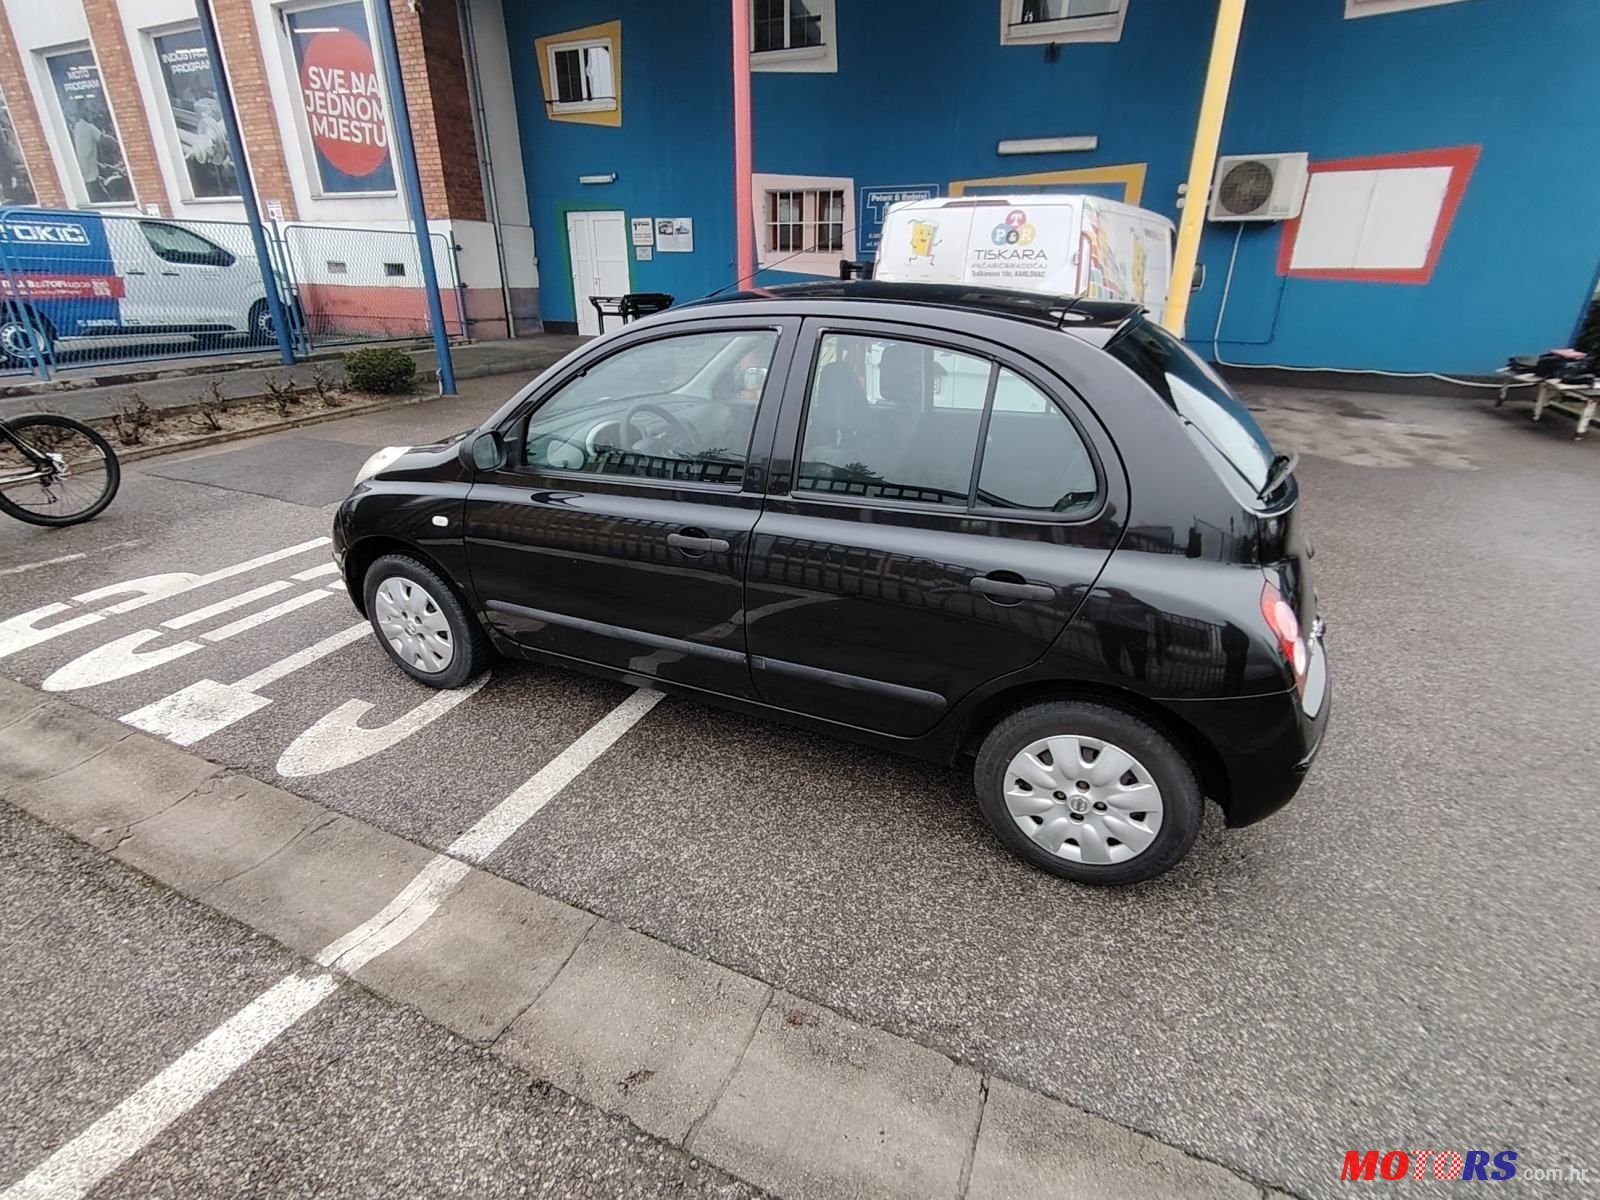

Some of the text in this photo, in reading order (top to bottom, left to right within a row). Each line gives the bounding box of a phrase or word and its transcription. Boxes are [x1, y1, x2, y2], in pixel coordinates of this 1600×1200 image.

[308, 65, 382, 97] SVE NA
[312, 114, 387, 147] MJESTU
[974, 249, 1048, 260] TISKARA
